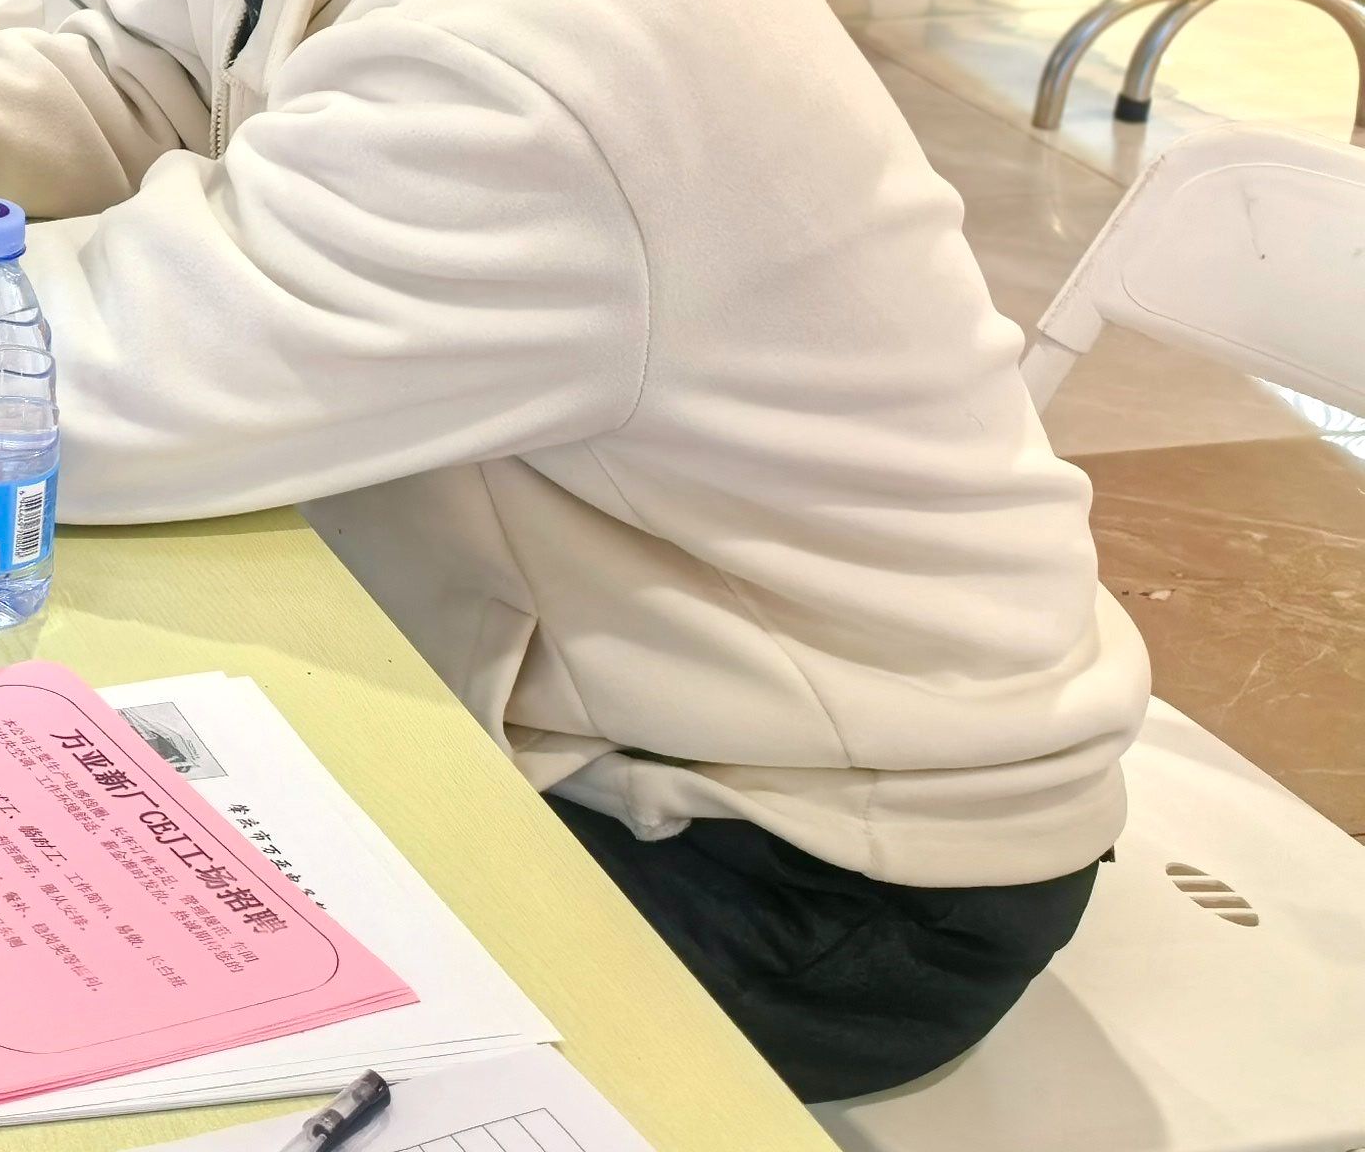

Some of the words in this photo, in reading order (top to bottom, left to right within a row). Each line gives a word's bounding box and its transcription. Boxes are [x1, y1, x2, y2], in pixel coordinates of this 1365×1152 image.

[49, 728, 288, 933] 万亚新厂CEJ工场招聘
[226, 803, 327, 910] 肇庆市万亚电
